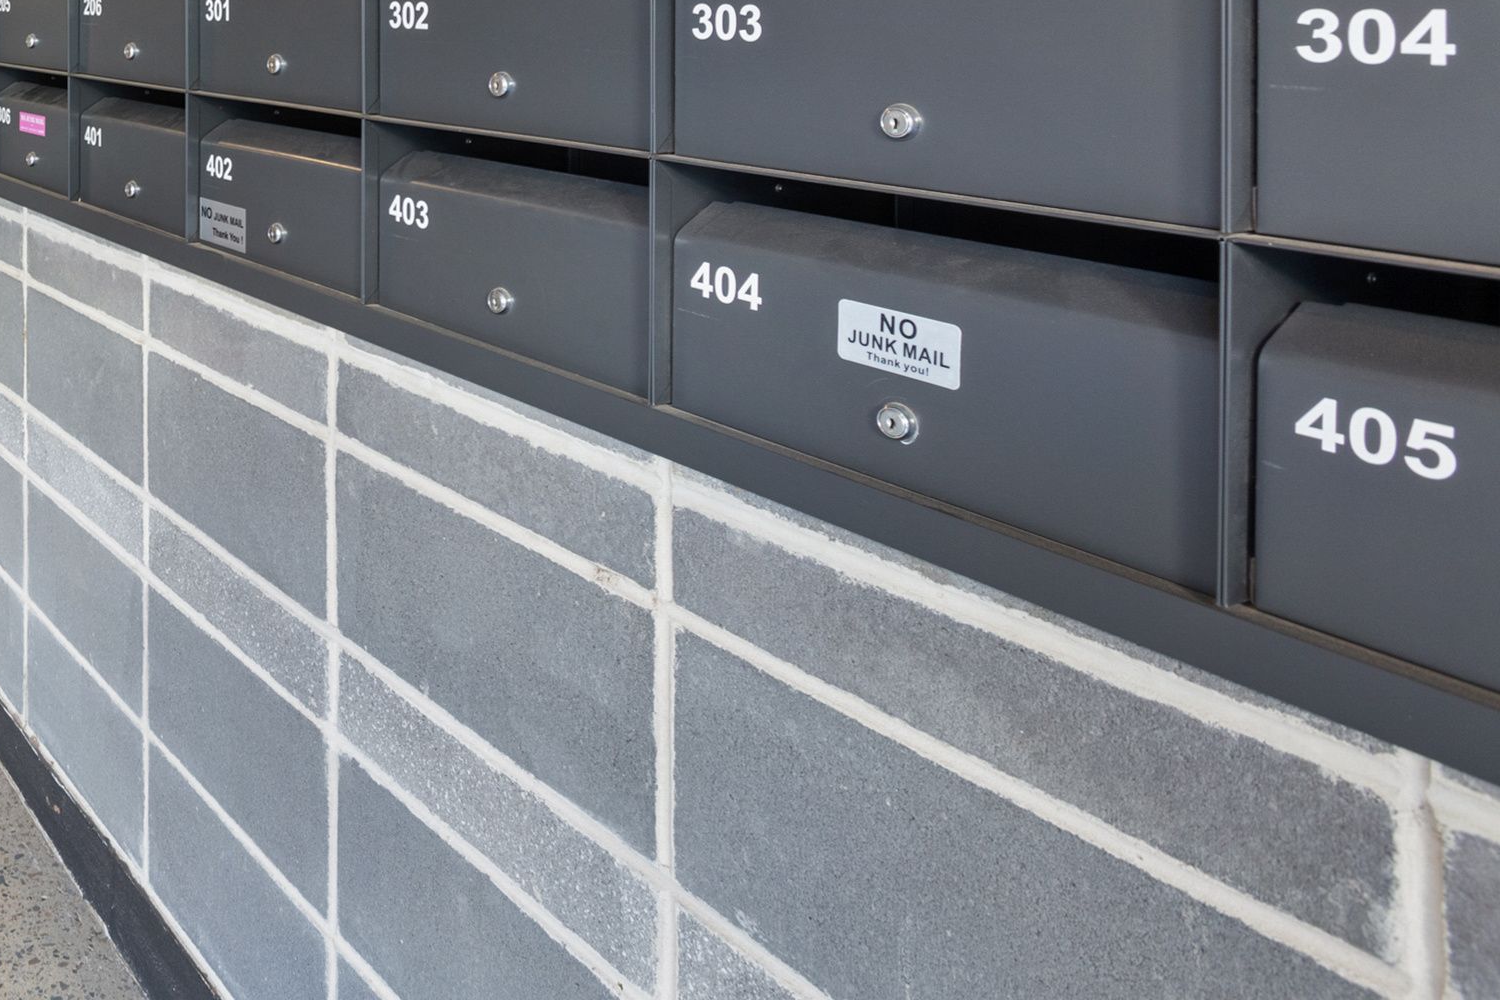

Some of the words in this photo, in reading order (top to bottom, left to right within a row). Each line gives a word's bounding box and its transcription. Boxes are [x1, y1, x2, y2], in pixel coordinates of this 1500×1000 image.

[388, 0, 429, 30] 302
[691, 3, 762, 42] 303
[1295, 8, 1457, 66] 304
[84, 125, 102, 147] 401
[206, 154, 233, 181] 402
[201, 206, 213, 219] NO
[214, 212, 229, 225] JUNK
[230, 215, 244, 229] MAIL
[388, 194, 429, 229] 403
[213, 227, 228, 240] Thank
[690, 261, 763, 311] 404
[880, 312, 918, 340] NO
[847, 329, 898, 356] JUNK
[902, 342, 950, 369] MAIL
[866, 351, 901, 369] Thank
[903, 361, 930, 377] you!
[1294, 397, 1457, 480] 405
